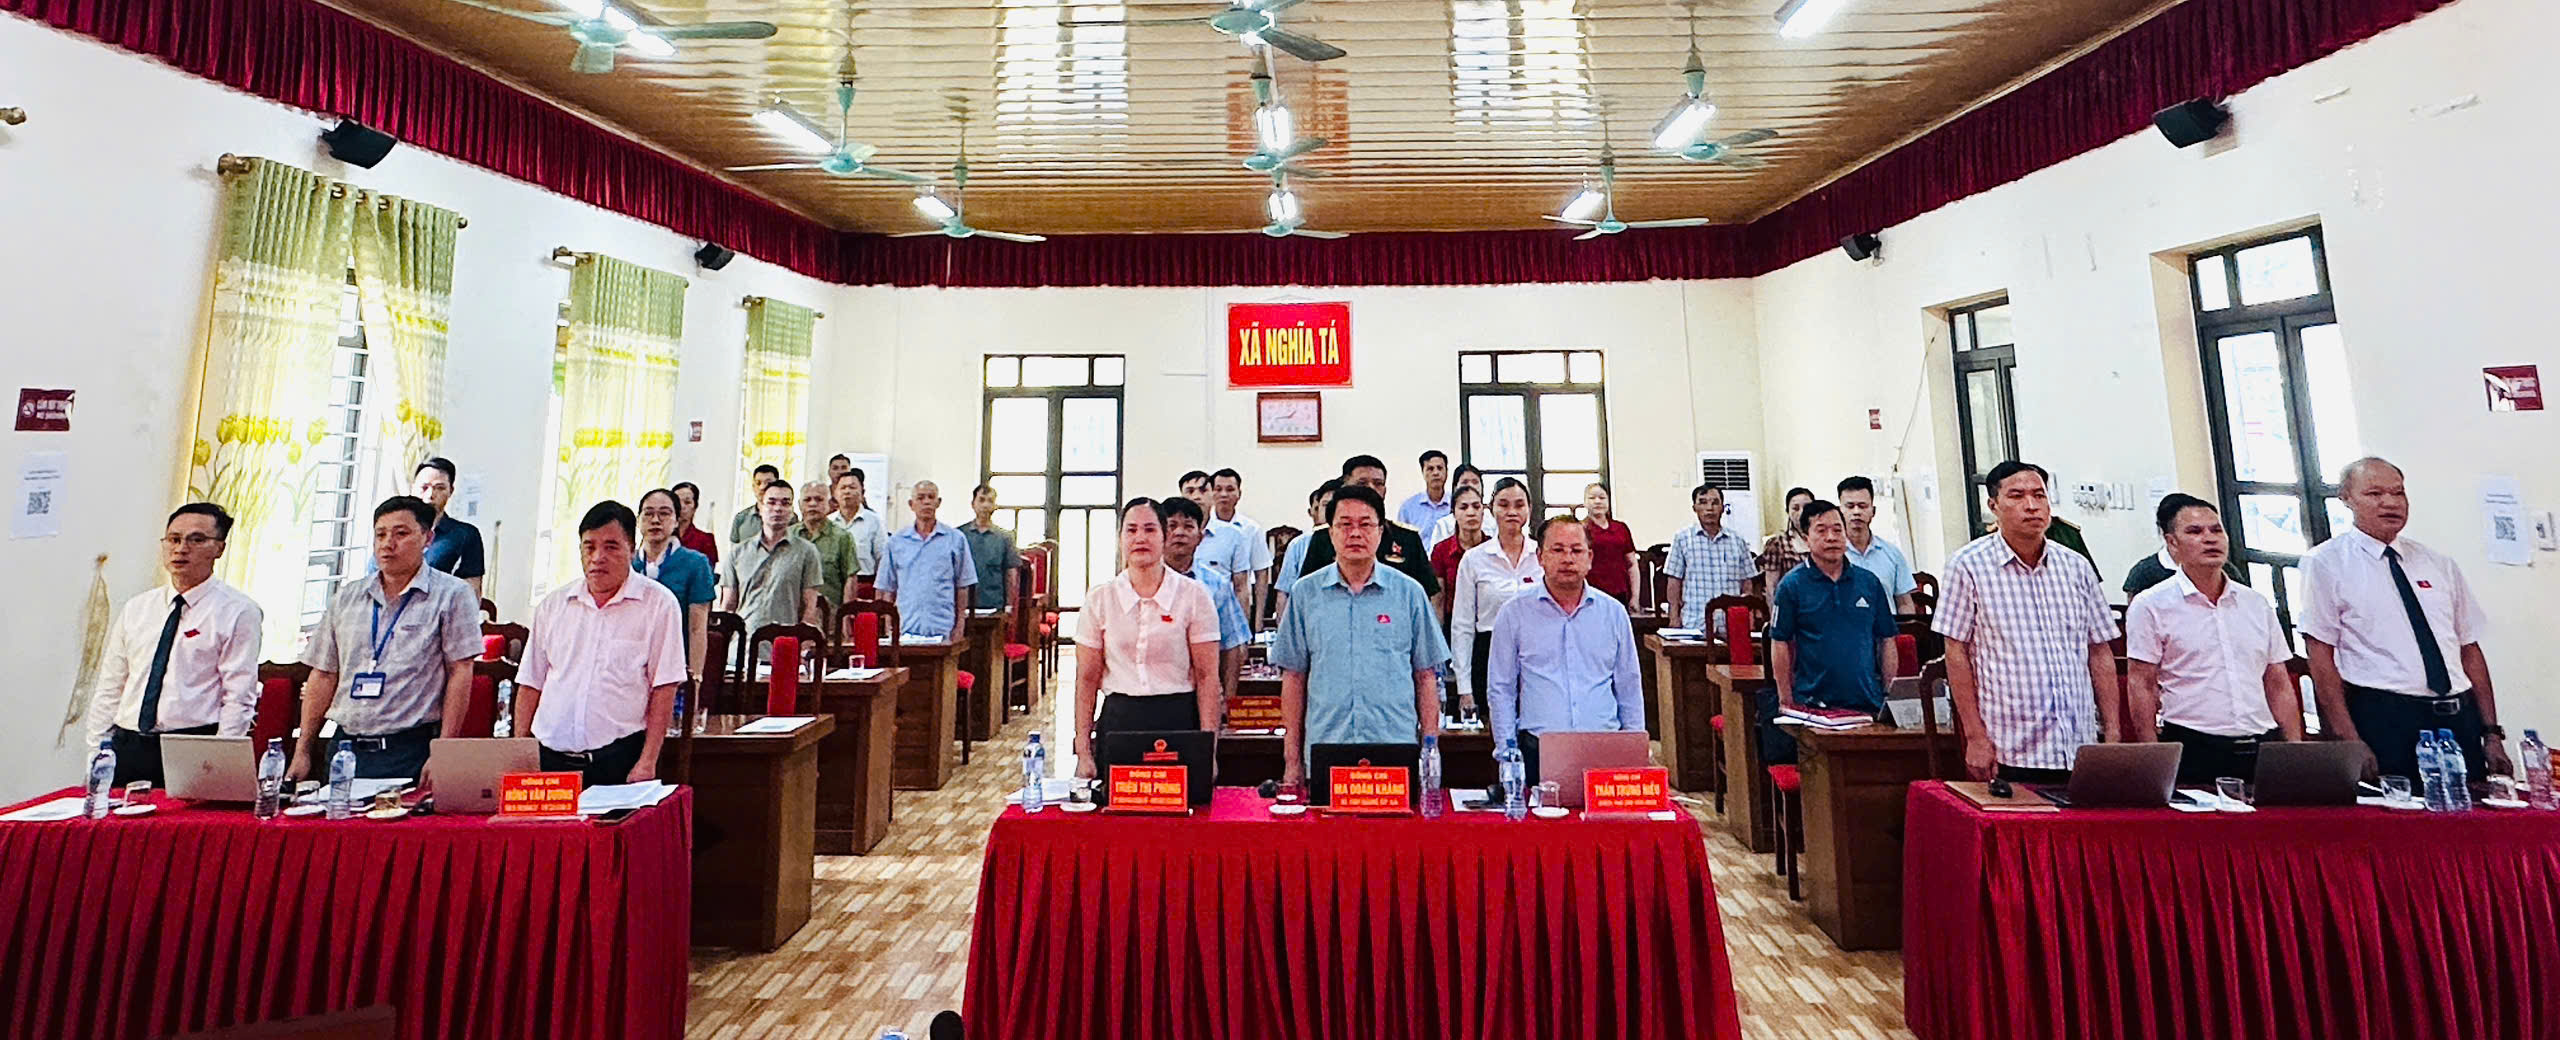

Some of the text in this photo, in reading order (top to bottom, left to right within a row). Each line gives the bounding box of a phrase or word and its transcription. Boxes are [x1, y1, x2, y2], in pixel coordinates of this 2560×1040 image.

[1239, 319, 1340, 366] XÃ NGHĨA TÁ
